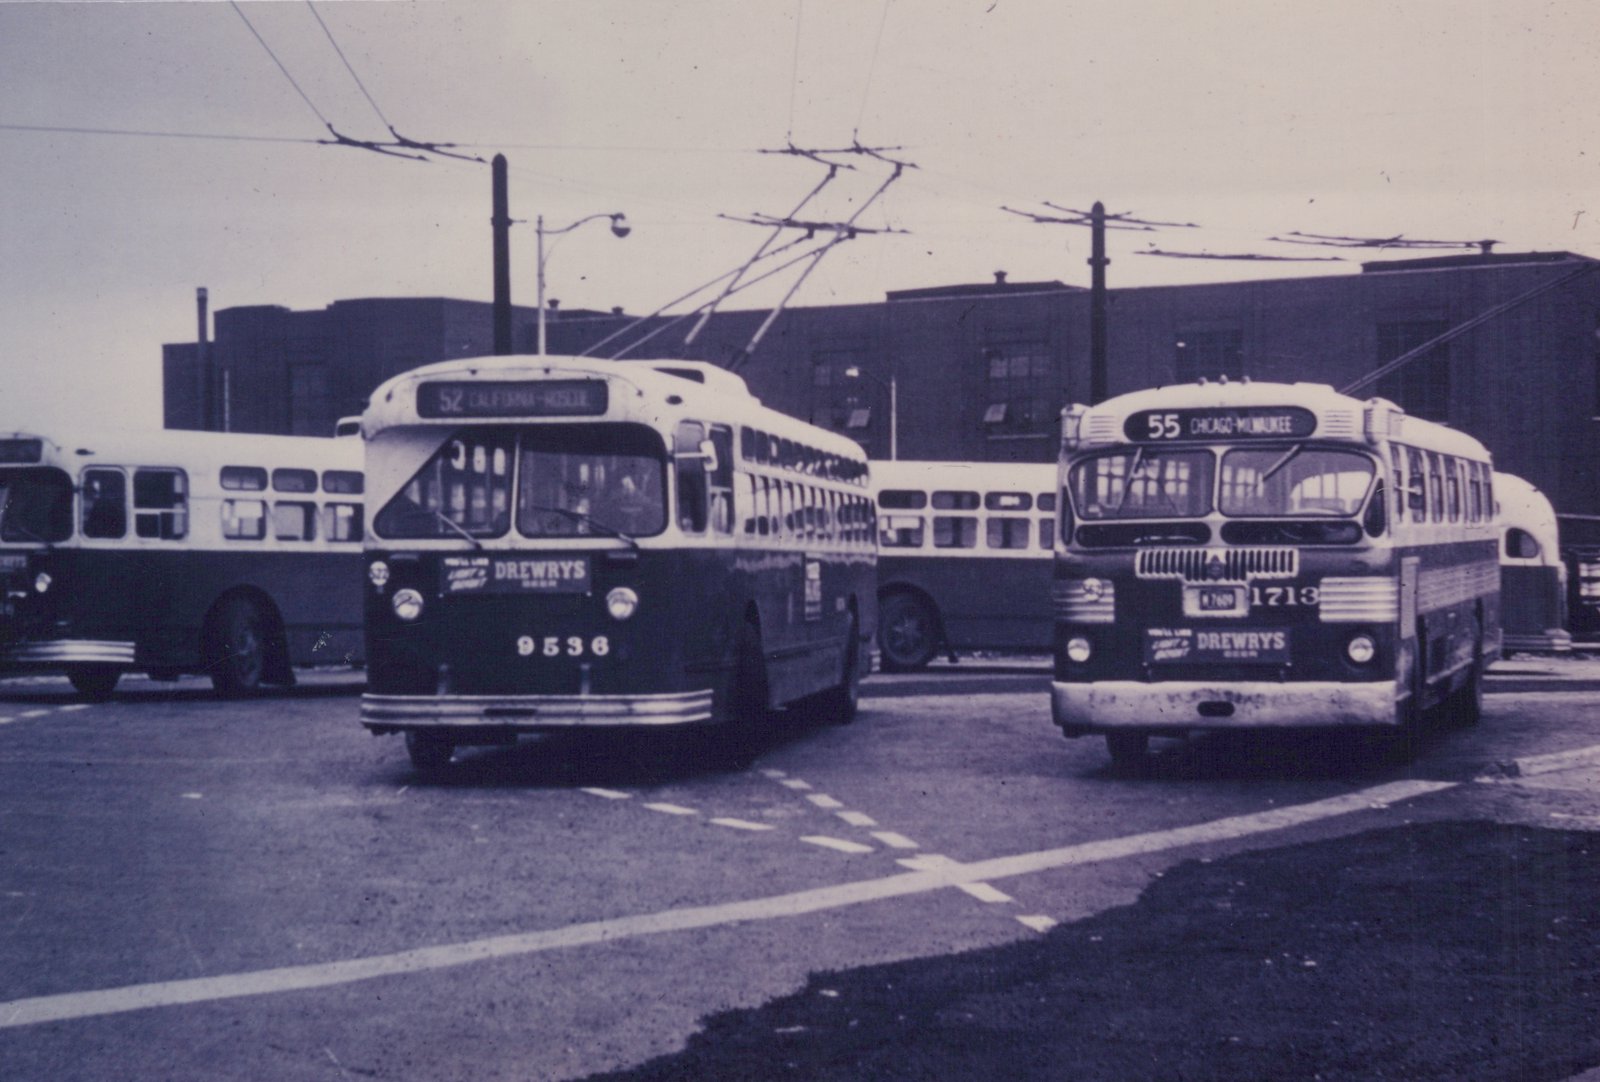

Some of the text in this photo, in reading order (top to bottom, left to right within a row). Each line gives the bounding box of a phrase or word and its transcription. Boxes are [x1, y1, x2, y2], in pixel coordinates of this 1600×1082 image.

[440, 388, 463, 412] 52
[1148, 414, 1181, 438] 55
[495, 560, 586, 580] DREWRYS
[1251, 587, 1320, 606] 1713
[517, 636, 609, 656] 9536
[1197, 632, 1286, 650] DREWRYS
